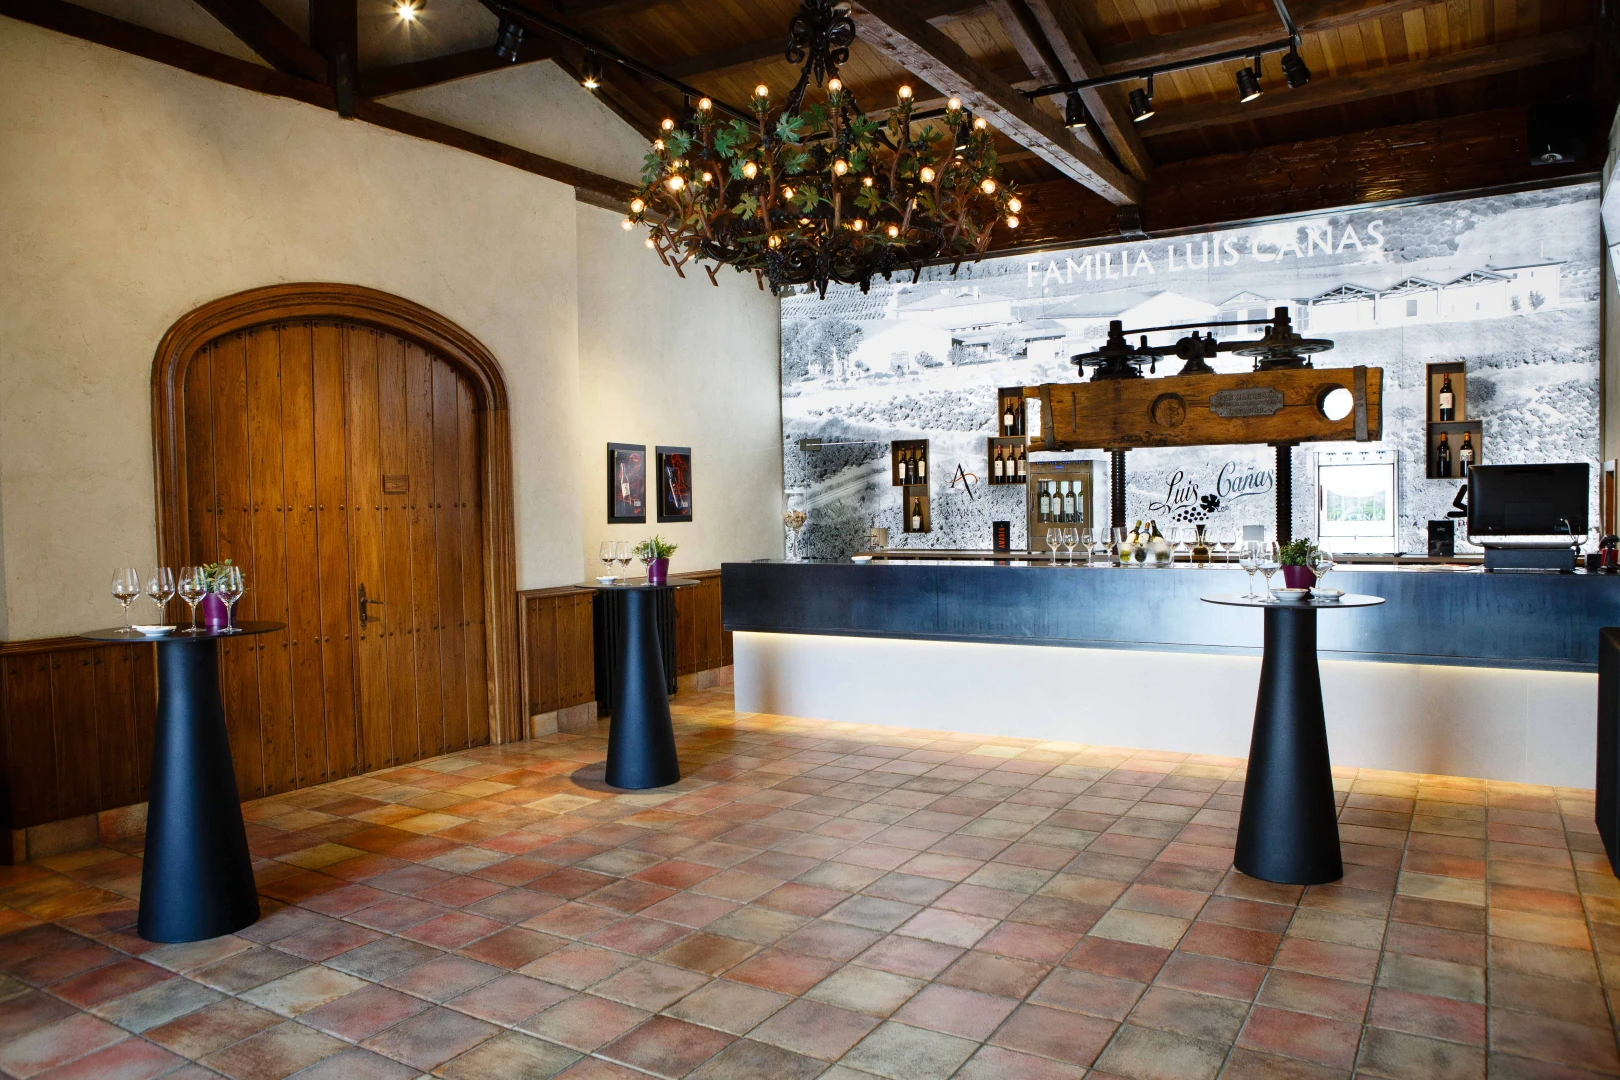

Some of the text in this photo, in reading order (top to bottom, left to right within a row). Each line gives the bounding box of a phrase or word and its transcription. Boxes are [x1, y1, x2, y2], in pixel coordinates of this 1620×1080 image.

[1027, 248, 1157, 287] FAMILIA
[1168, 237, 1240, 273] LUIS
[1149, 461, 1274, 516] Luis Cañas
